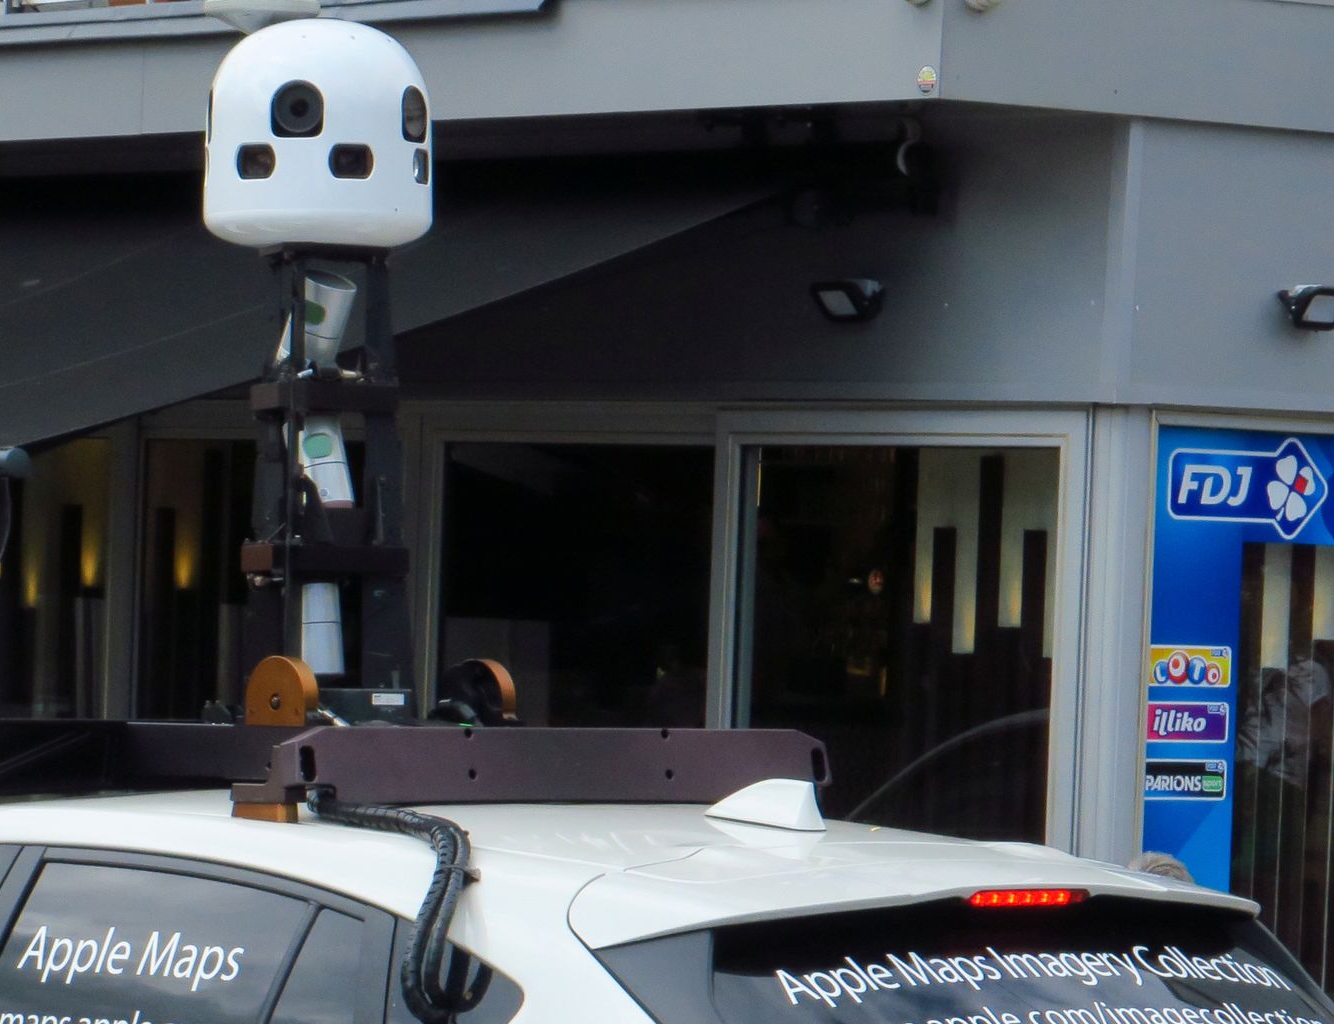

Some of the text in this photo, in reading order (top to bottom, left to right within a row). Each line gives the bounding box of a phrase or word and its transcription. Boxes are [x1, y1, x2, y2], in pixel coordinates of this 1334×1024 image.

[1177, 464, 1252, 506] FDJ
[1154, 650, 1221, 685] LOTO
[1153, 708, 1207, 735] illiko
[1145, 775, 1202, 792] PARIONS
[17, 925, 245, 992] Apple Maps
[775, 945, 1292, 1008] Apple Maps Imagery Collection
